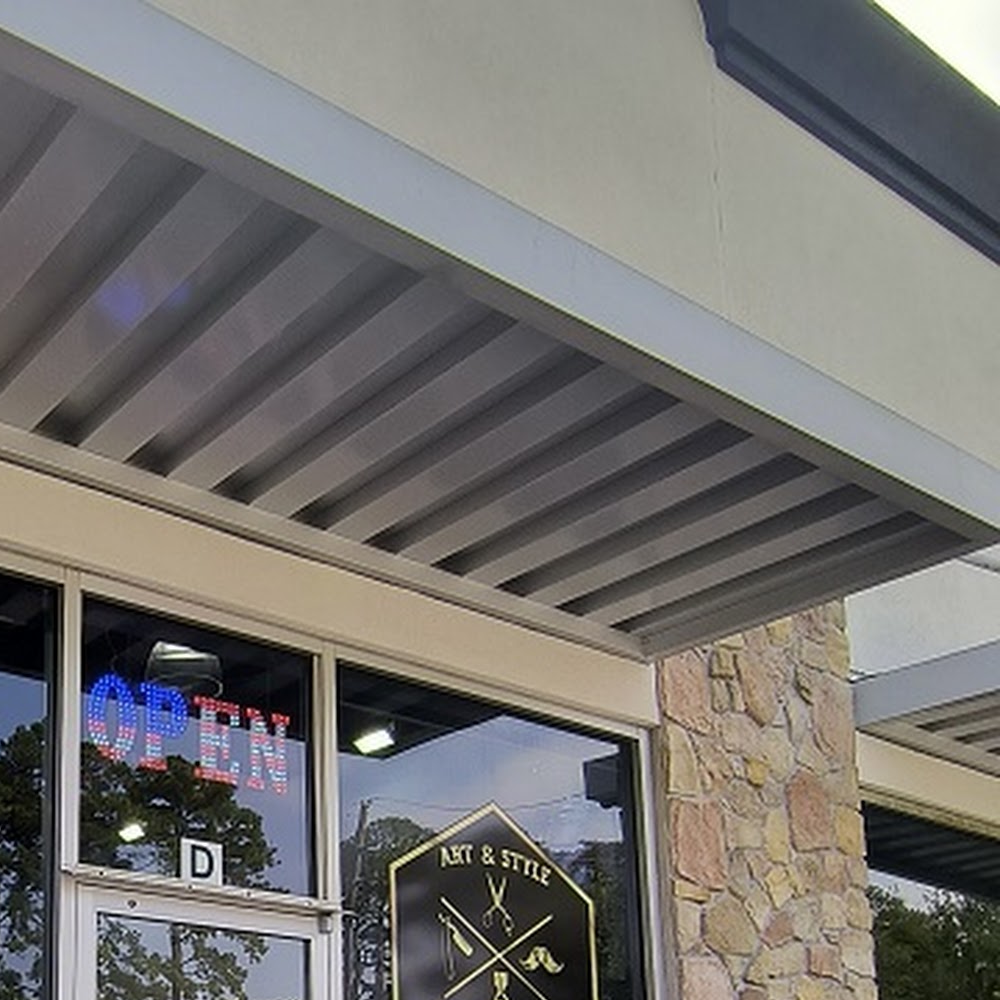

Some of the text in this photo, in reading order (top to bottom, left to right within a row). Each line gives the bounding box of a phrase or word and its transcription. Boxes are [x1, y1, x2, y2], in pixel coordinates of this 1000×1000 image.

[86, 673, 291, 797] OPEN
[190, 844, 215, 879] D
[439, 844, 552, 887] ART & STYLE
